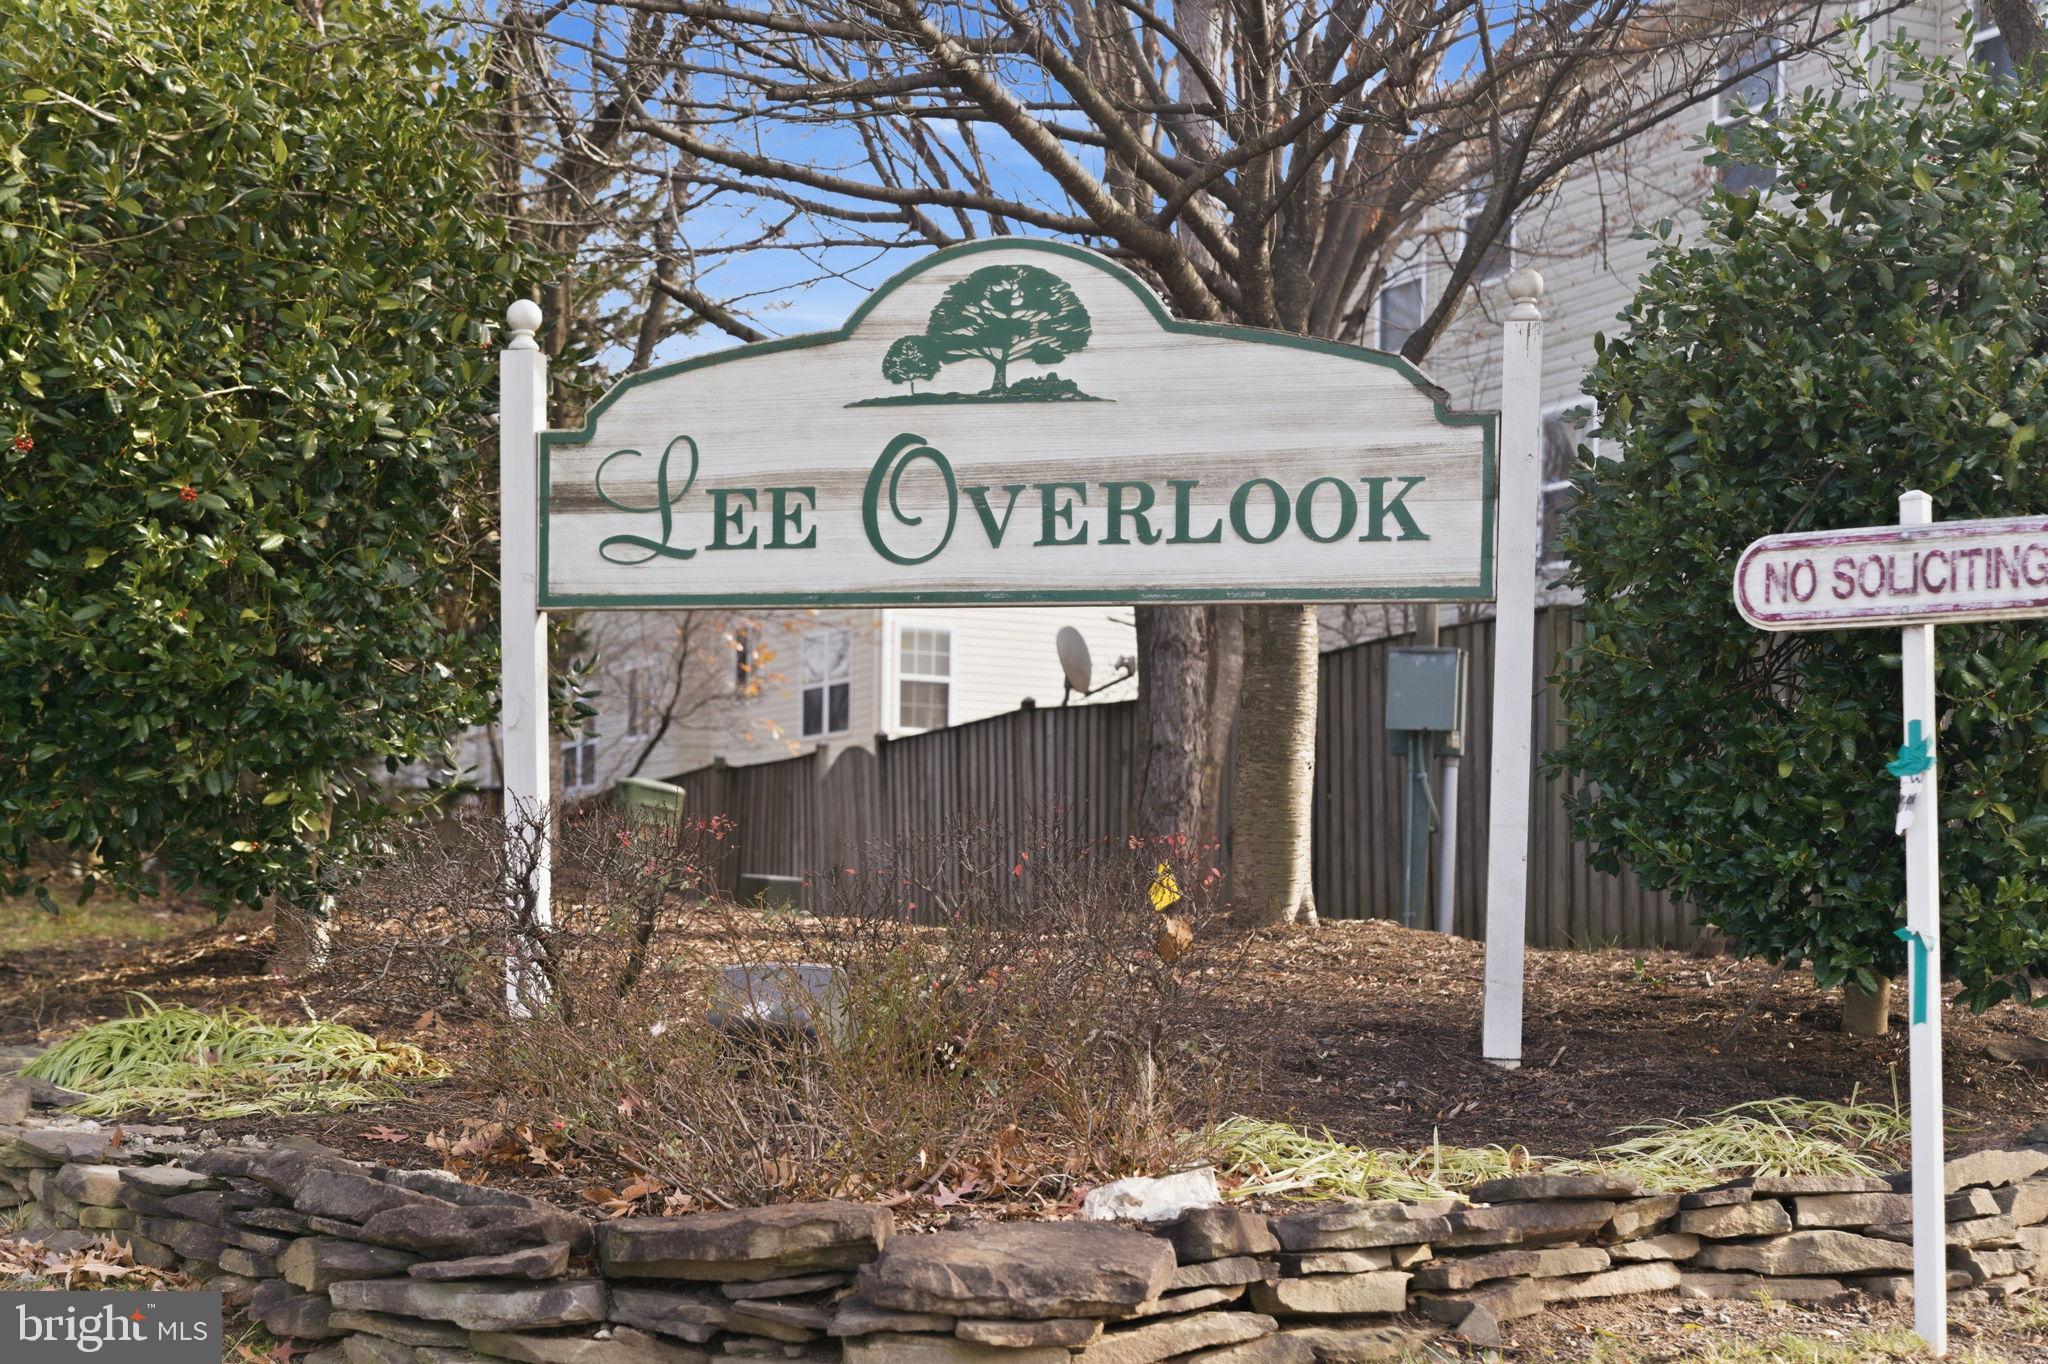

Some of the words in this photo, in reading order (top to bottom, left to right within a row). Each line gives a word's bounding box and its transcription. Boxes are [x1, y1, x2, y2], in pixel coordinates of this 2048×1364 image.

[596, 434, 817, 565] LEE
[861, 432, 1431, 566] OVERLOOK
[1764, 558, 1818, 604] NO
[1831, 542, 2048, 600] SOLICITING
